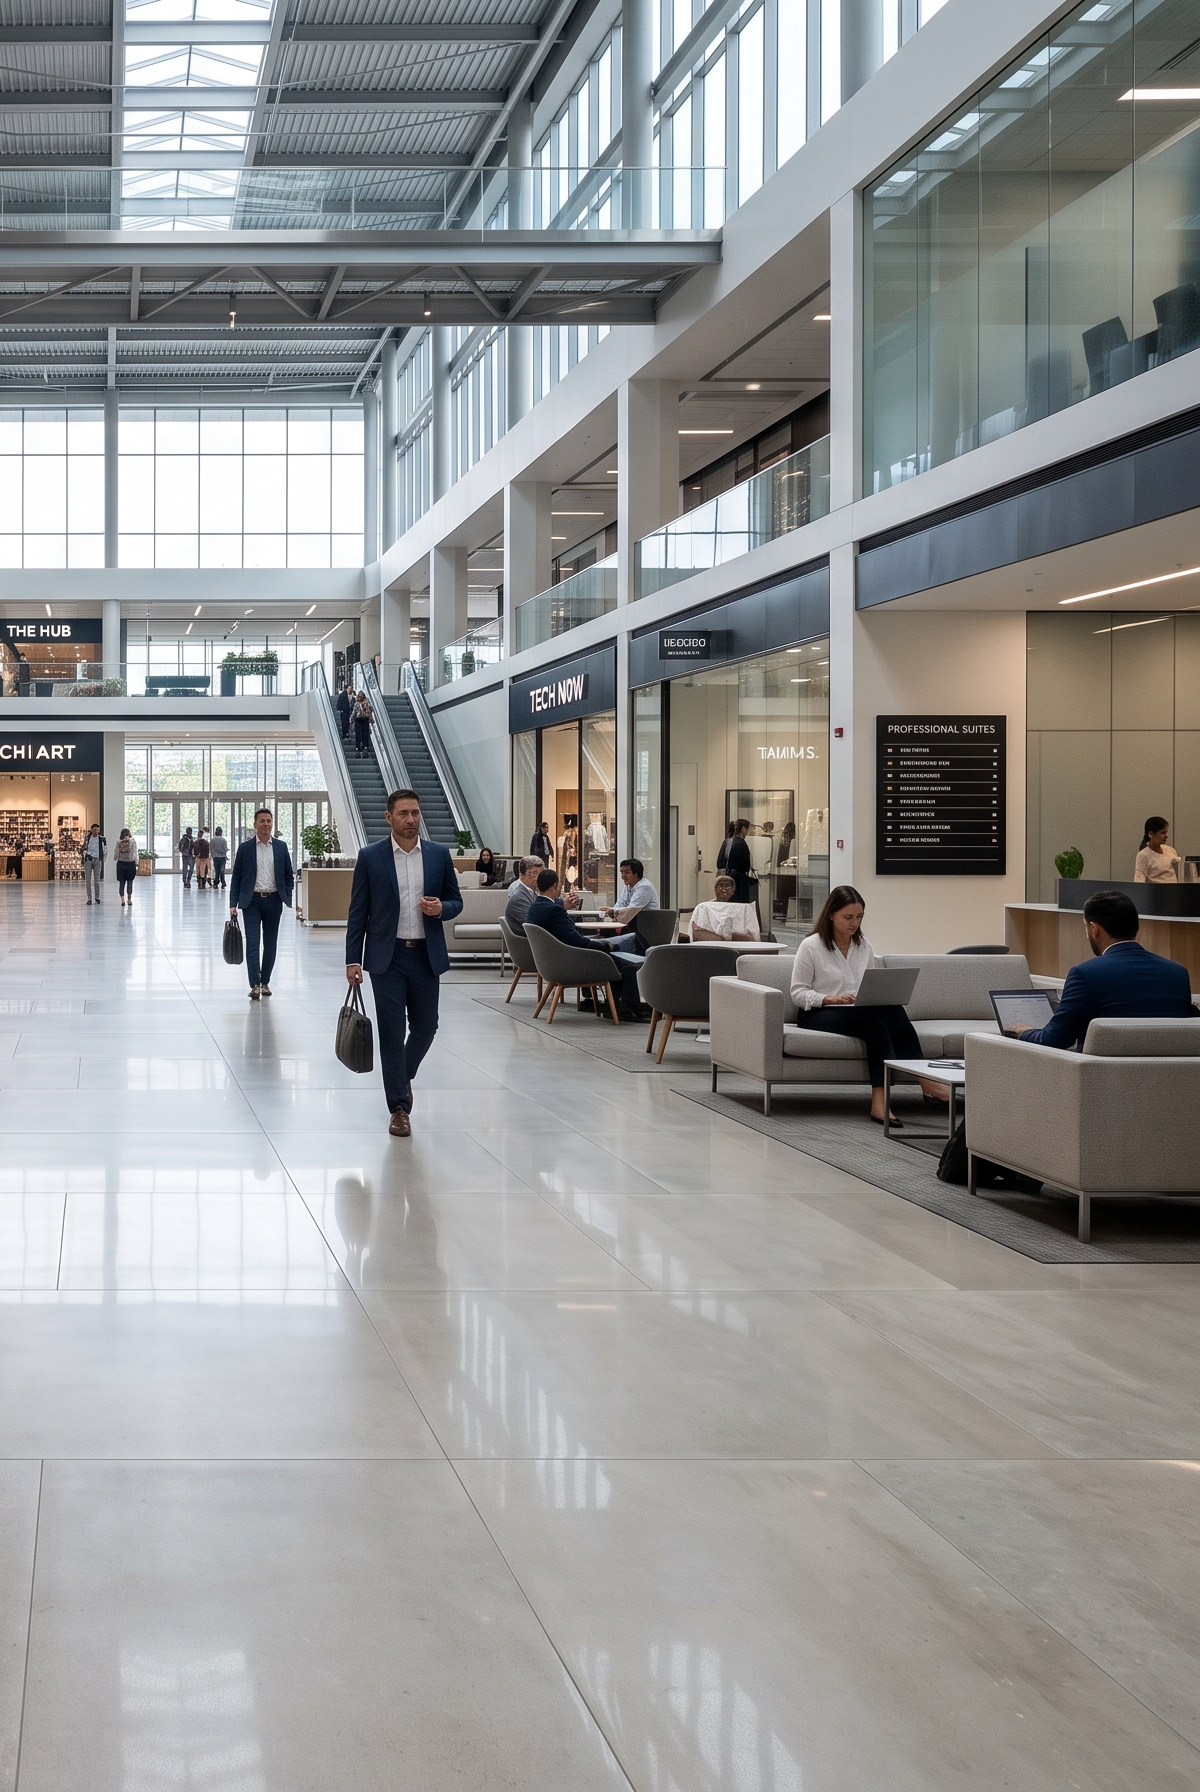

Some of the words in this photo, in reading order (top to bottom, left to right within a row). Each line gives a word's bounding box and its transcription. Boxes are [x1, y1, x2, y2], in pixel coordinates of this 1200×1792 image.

[6, 625, 36, 638] THE
[40, 625, 72, 638] HUB
[529, 683, 556, 713] TECH
[558, 673, 585, 706] NOW
[887, 724, 960, 734] PROFESSIONAL
[962, 724, 996, 734] SUITES
[35, 744, 76, 760] ART
